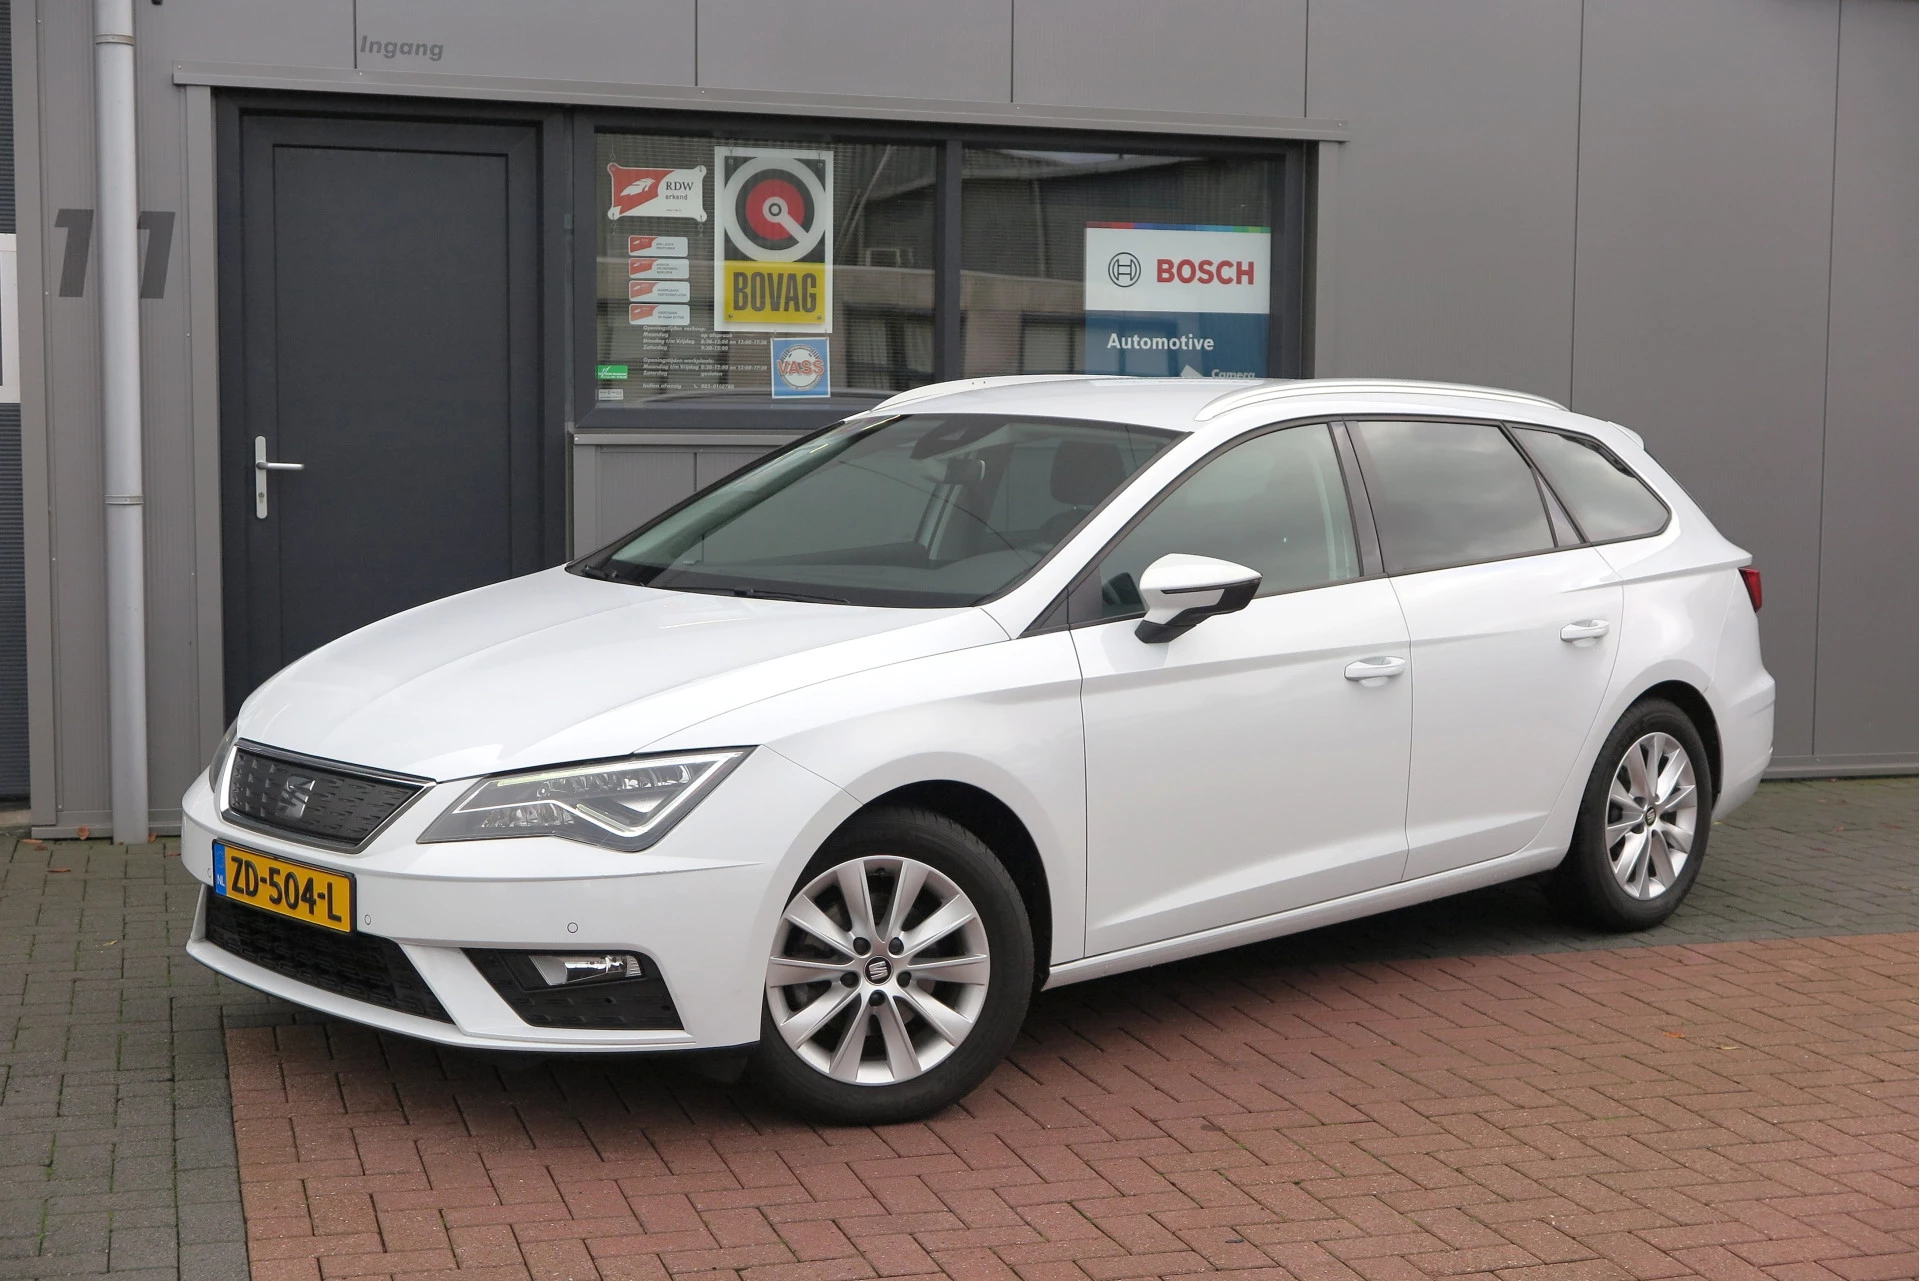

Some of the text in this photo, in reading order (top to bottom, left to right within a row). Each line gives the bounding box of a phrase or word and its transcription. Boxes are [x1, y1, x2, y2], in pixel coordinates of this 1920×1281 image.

[360, 35, 444, 62] Ingang
[665, 181, 694, 191] RDW
[54, 208, 176, 299] 11
[1156, 258, 1254, 285] BOSCH
[733, 271, 817, 313] BOVAG
[1107, 333, 1215, 350] Automotive
[777, 359, 825, 375] VASS
[1211, 368, 1256, 379] Camera
[216, 873, 225, 887] NL
[230, 855, 342, 923] ZD-504-L
